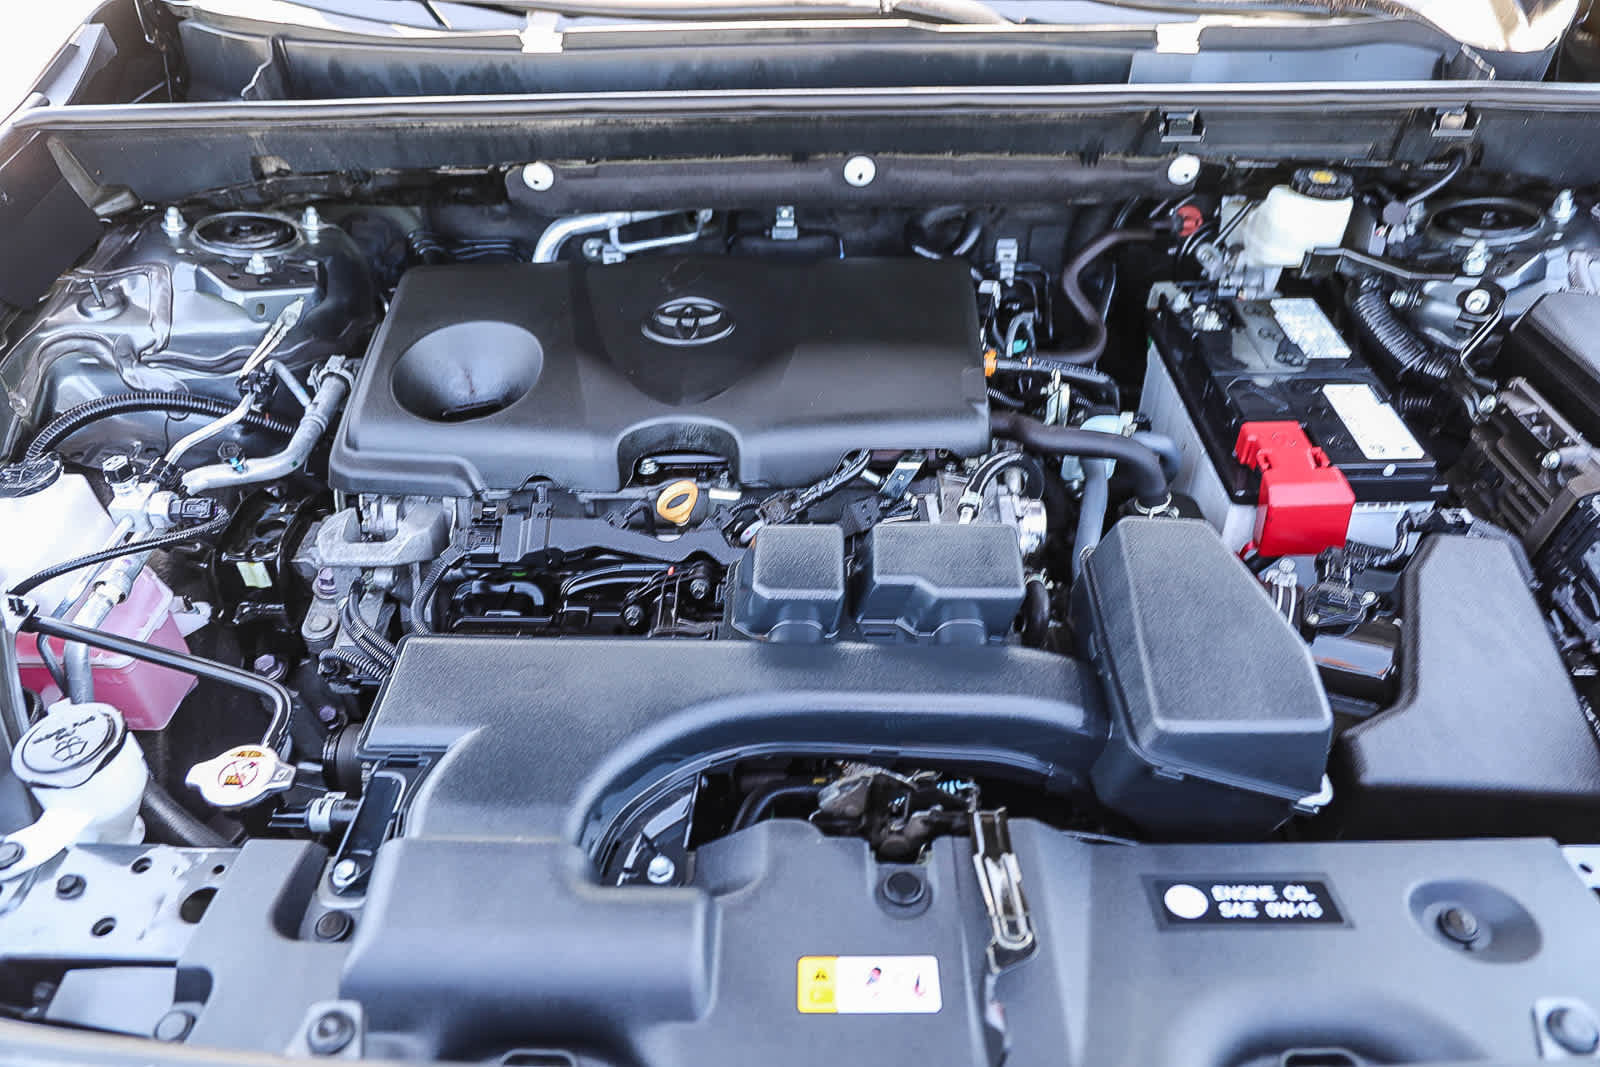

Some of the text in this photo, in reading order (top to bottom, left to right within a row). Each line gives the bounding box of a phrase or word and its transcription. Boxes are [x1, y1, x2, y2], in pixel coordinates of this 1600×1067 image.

[1211, 885, 1316, 902] ENGINE OIL
[1218, 902, 1260, 918] SAE
